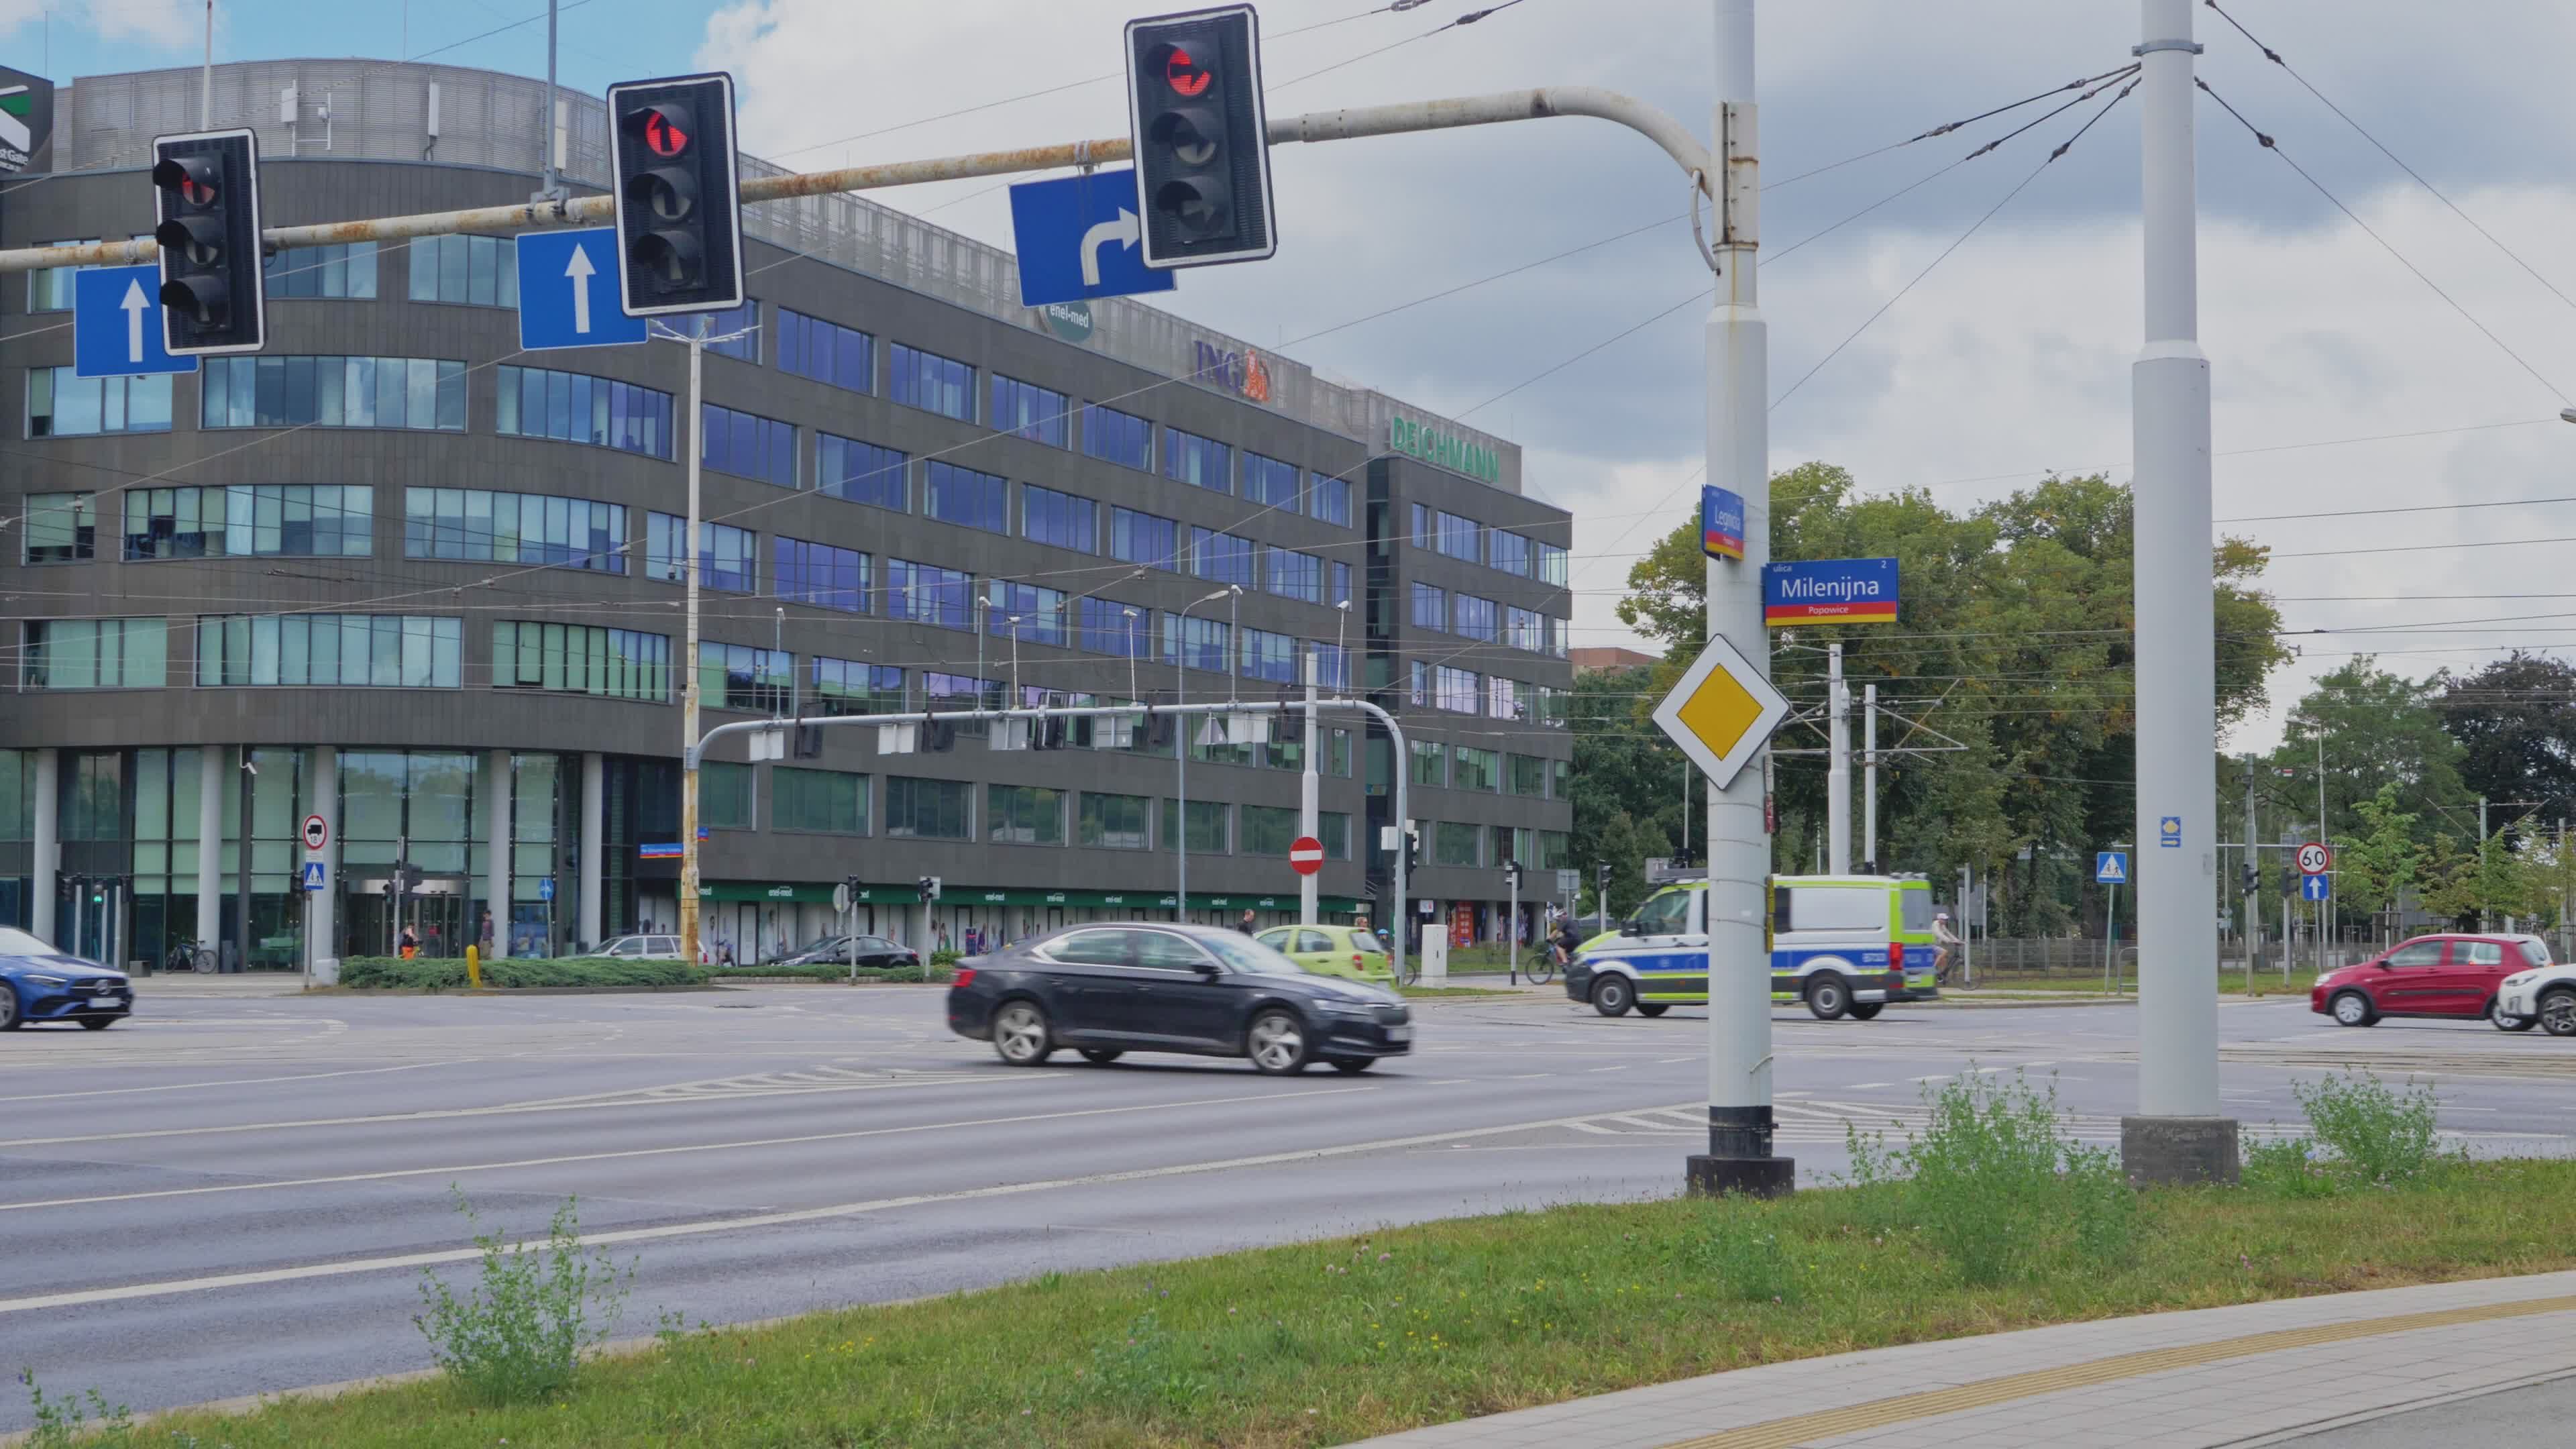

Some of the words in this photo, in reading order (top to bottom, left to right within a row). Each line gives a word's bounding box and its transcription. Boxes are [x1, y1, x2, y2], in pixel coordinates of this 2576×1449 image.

[7, 150, 28, 166] Gate
[1194, 340, 1240, 392] ING
[1393, 416, 1499, 483] DEICHMANN
[1773, 564, 1792, 572] ulica
[1881, 560, 1886, 568] 2
[1781, 576, 1879, 601] Milenijna
[1809, 606, 1849, 615] Popowice
[2302, 851, 2324, 866] 60
